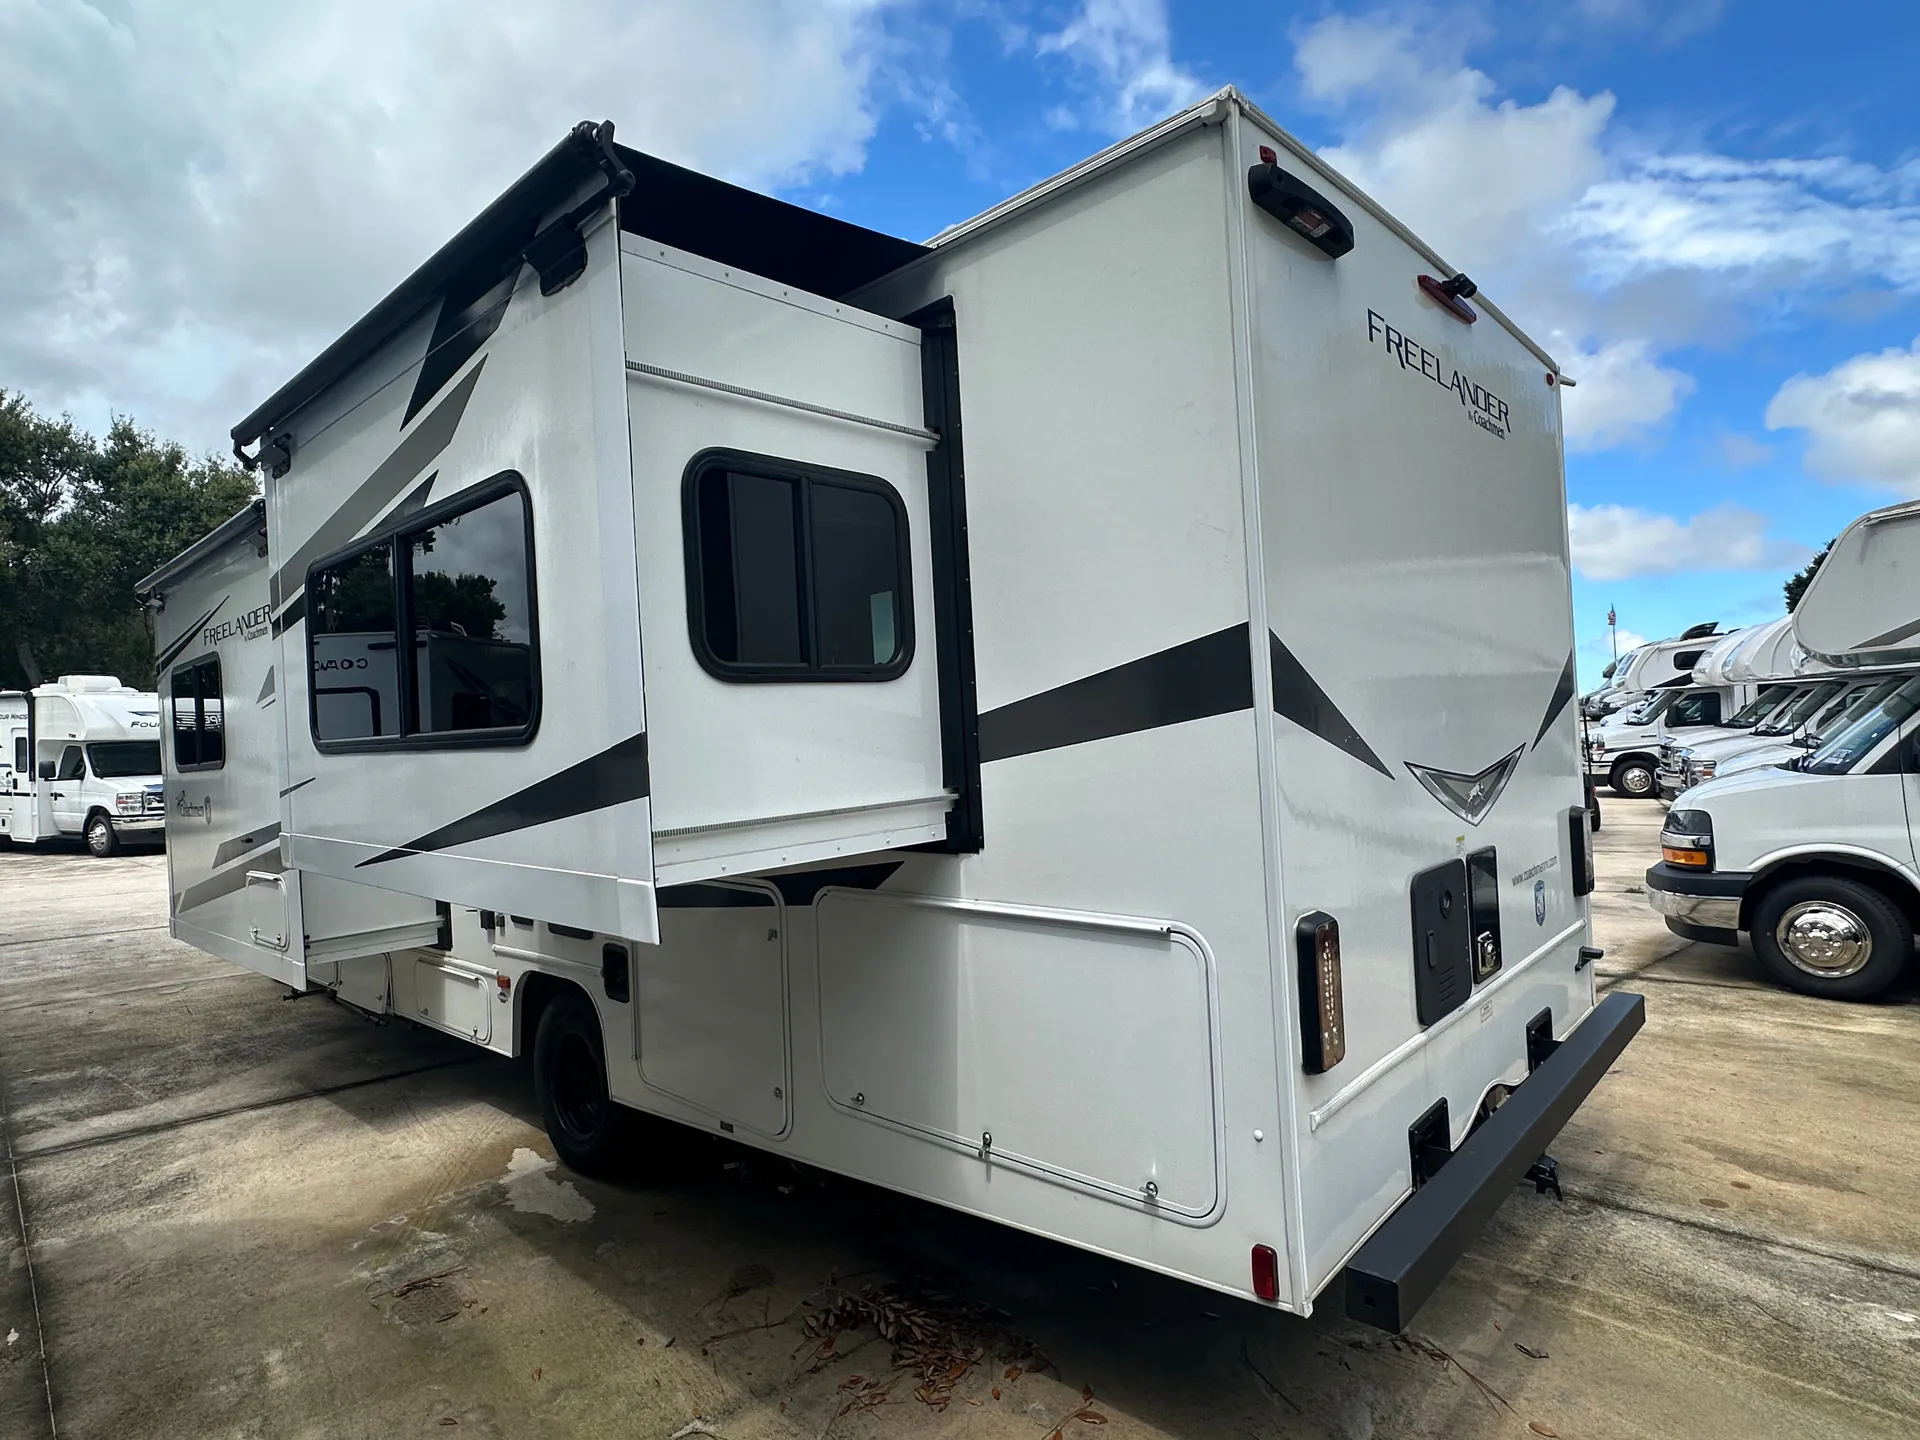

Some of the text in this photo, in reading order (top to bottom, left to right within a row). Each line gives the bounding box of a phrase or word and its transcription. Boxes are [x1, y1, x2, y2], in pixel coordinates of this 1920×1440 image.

[1367, 308, 1511, 433] FREELANDER
[1473, 410, 1506, 440] Coachmen
[203, 604, 273, 646] FREELANDER
